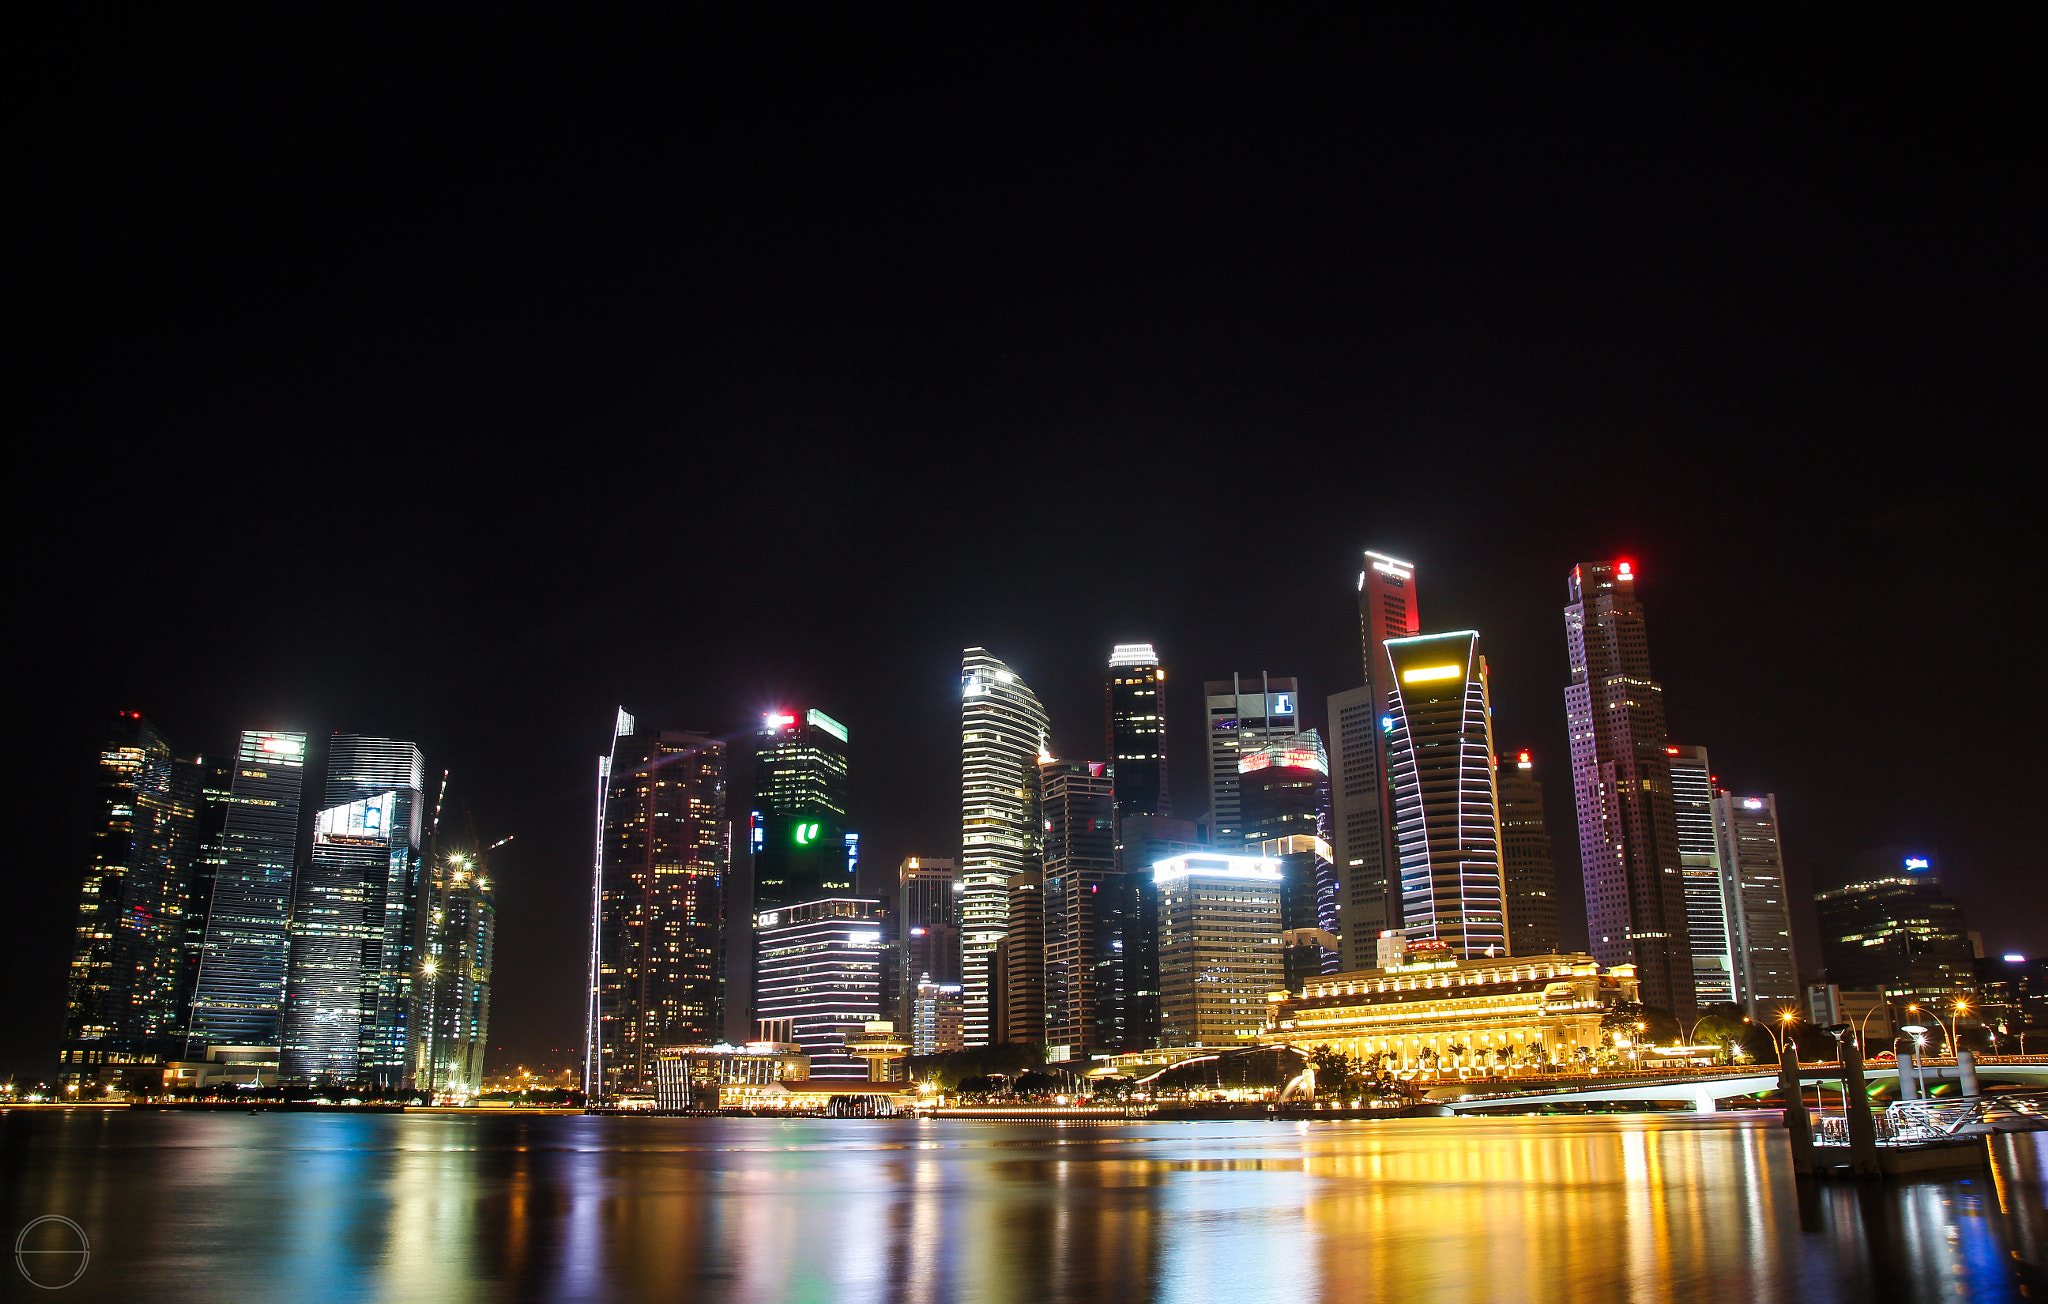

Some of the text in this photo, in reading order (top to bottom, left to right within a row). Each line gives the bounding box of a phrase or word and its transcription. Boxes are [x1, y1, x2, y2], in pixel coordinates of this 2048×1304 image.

[1285, 752, 1315, 760] STRAITS
[758, 912, 778, 926] OUE
[1384, 961, 1458, 974] THE FULLERTON HOTEL
